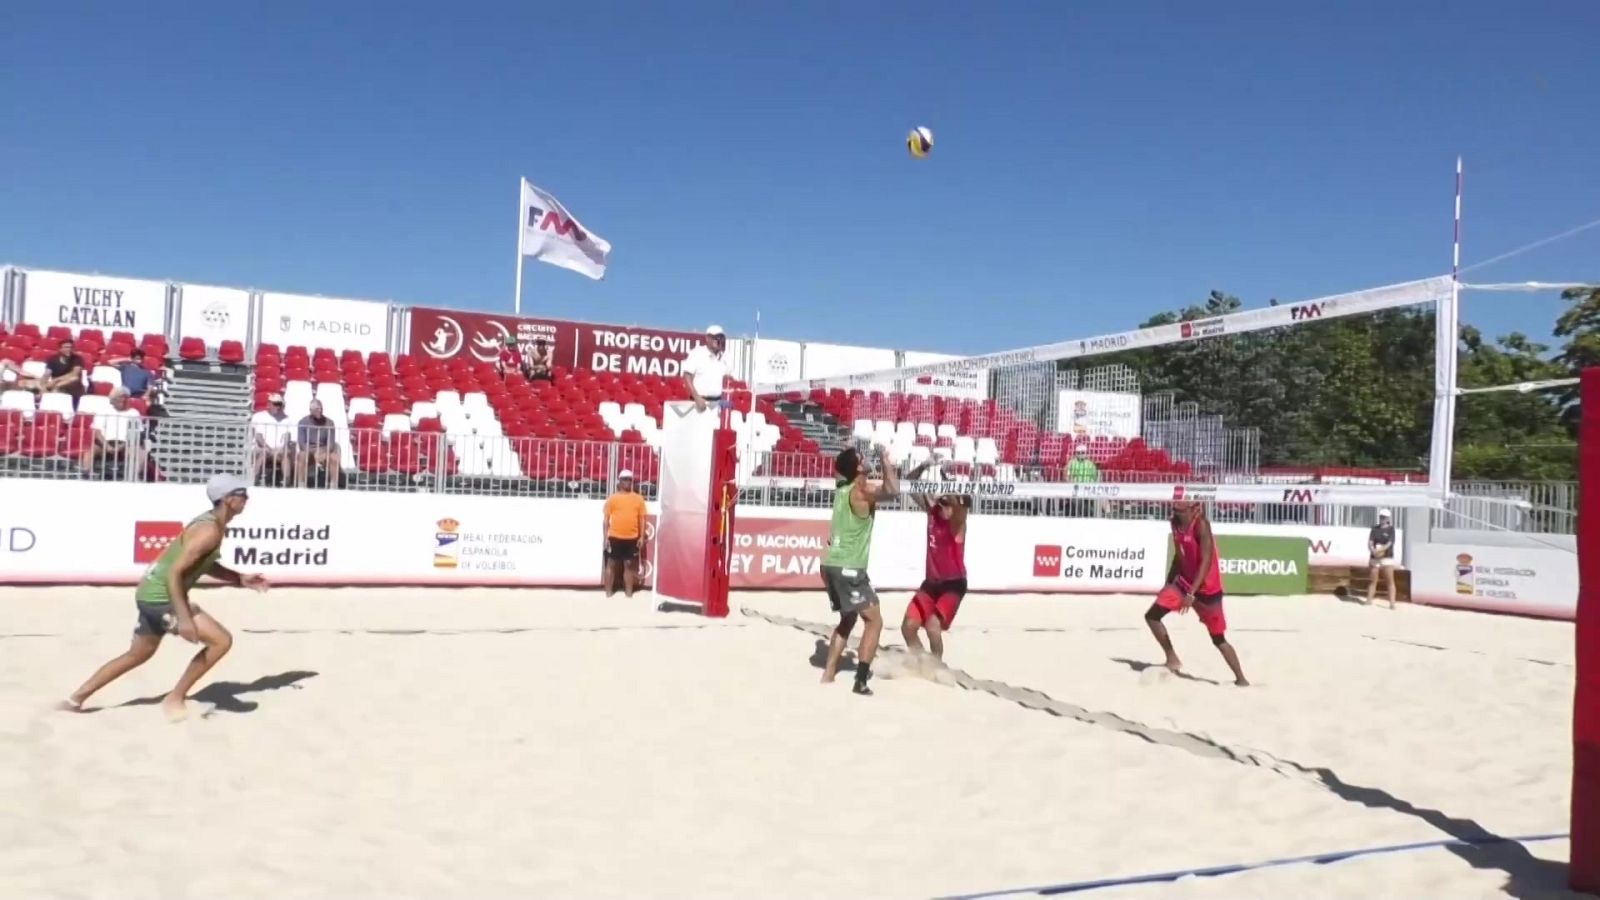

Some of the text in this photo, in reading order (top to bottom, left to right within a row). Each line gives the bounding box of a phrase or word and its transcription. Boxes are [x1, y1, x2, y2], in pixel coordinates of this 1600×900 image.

[73, 286, 124, 307] VICHY
[59, 305, 136, 328] CATALAN
[302, 319, 371, 336] MADRID
[592, 330, 665, 352] TROFEO
[1090, 336, 1128, 349] MADRID
[591, 353, 684, 377] DE MAD
[910, 482, 1015, 495] TROFEO VILLA DE MADRID
[1084, 485, 1120, 497] MADRID
[756, 534, 823, 549] NACIONAL
[234, 546, 328, 565] Madrid
[1065, 545, 1145, 560] Comunidad
[1064, 564, 1144, 579] de Madrid
